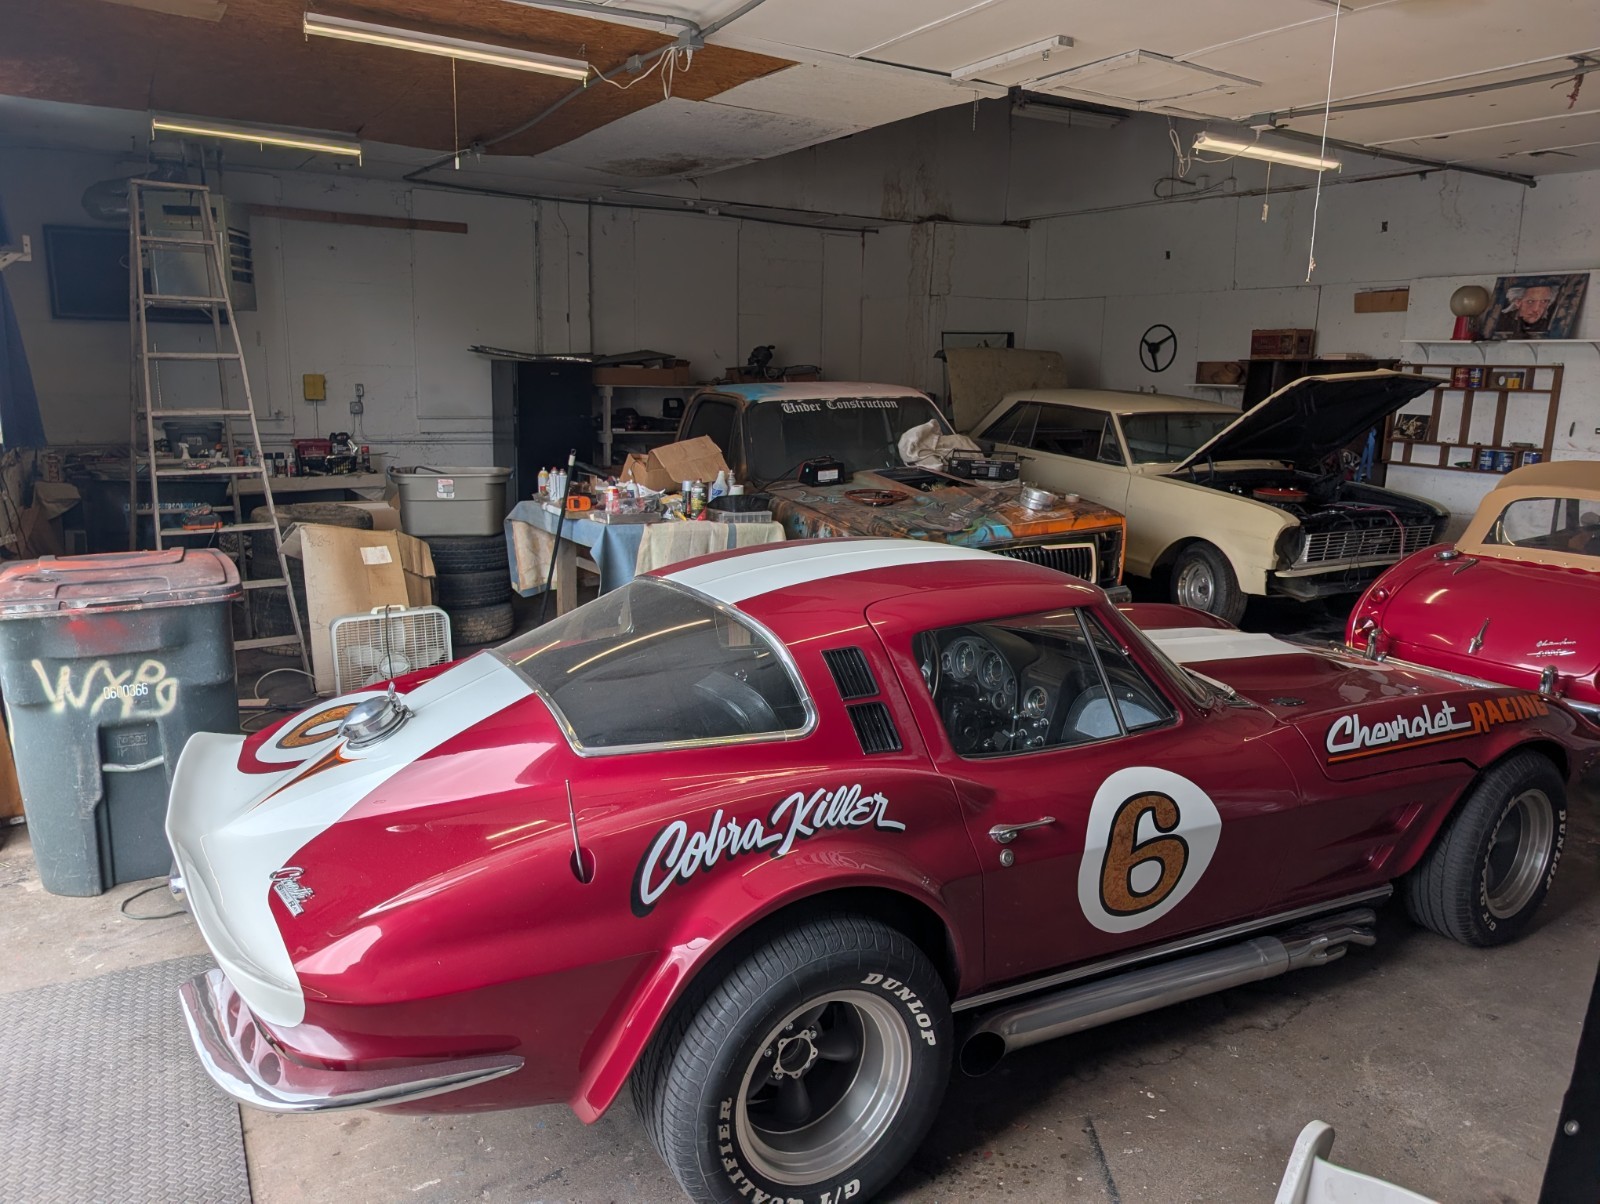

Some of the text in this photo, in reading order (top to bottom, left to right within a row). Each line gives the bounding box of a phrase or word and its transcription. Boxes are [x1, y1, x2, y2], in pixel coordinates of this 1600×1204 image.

[780, 399, 899, 414] Under Construction
[1326, 694, 1550, 753] Chevrolet RACING
[635, 809, 784, 908] Cobra
[1098, 790, 1190, 917] 6
[1546, 809, 1567, 891] DUNLOP
[860, 972, 937, 1046] DUNLOP
[717, 1096, 805, 1204] ALIFIER
